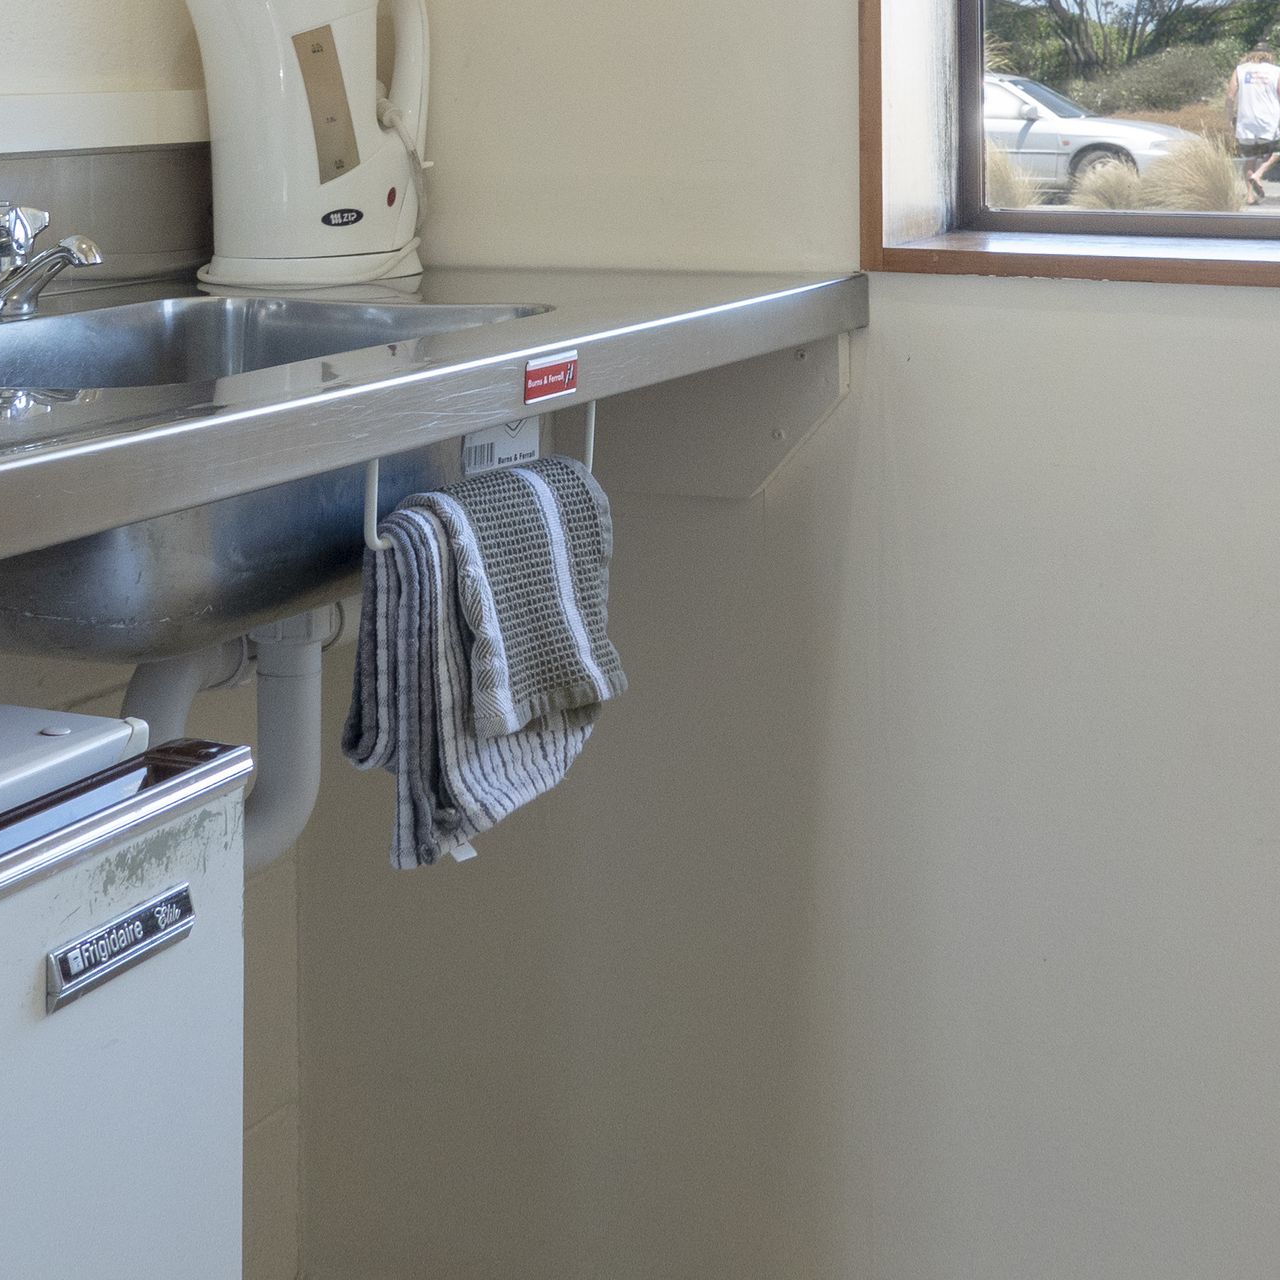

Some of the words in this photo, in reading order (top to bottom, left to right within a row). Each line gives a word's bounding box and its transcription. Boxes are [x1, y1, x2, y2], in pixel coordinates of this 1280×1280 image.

[342, 212, 357, 222] ZIP
[528, 379, 543, 388] Burns
[543, 375, 548, 385] &
[549, 371, 565, 383] Ferrall
[498, 456, 512, 465] Burns
[513, 453, 517, 461] &
[519, 449, 535, 459] Ferrall
[80, 920, 144, 969] Frigidaire
